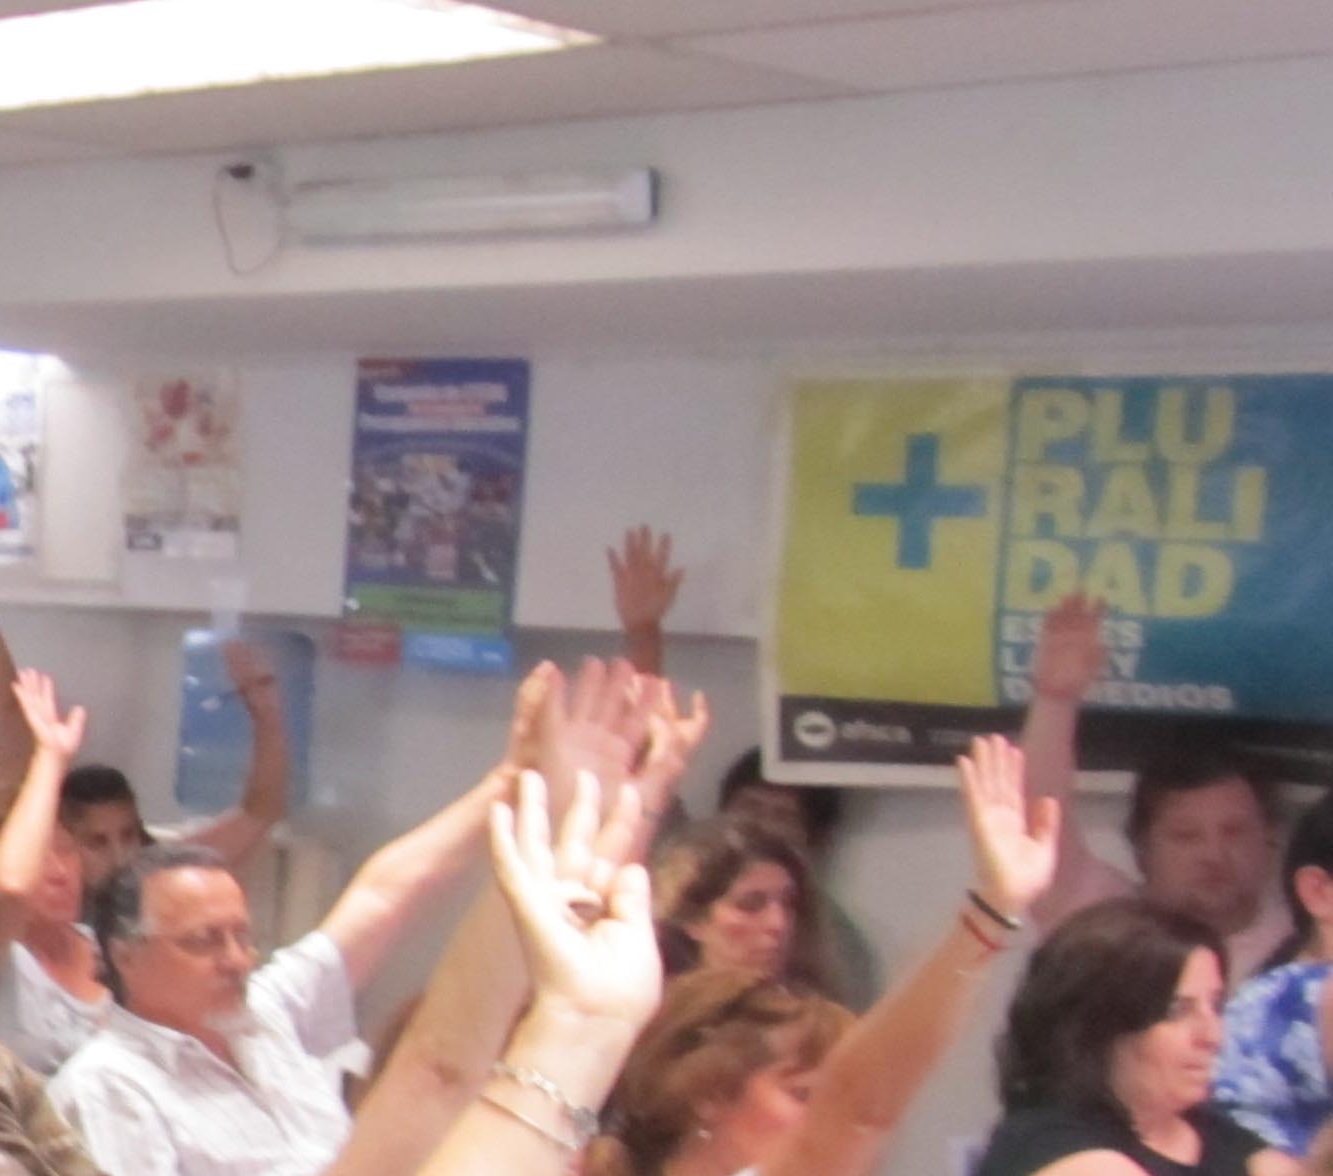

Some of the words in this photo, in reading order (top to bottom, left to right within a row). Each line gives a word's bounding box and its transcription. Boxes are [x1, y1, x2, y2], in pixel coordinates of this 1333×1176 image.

[1016, 387, 1236, 464] PLU
[1011, 463, 1267, 543] RALI
[1005, 536, 1233, 619] DAD
